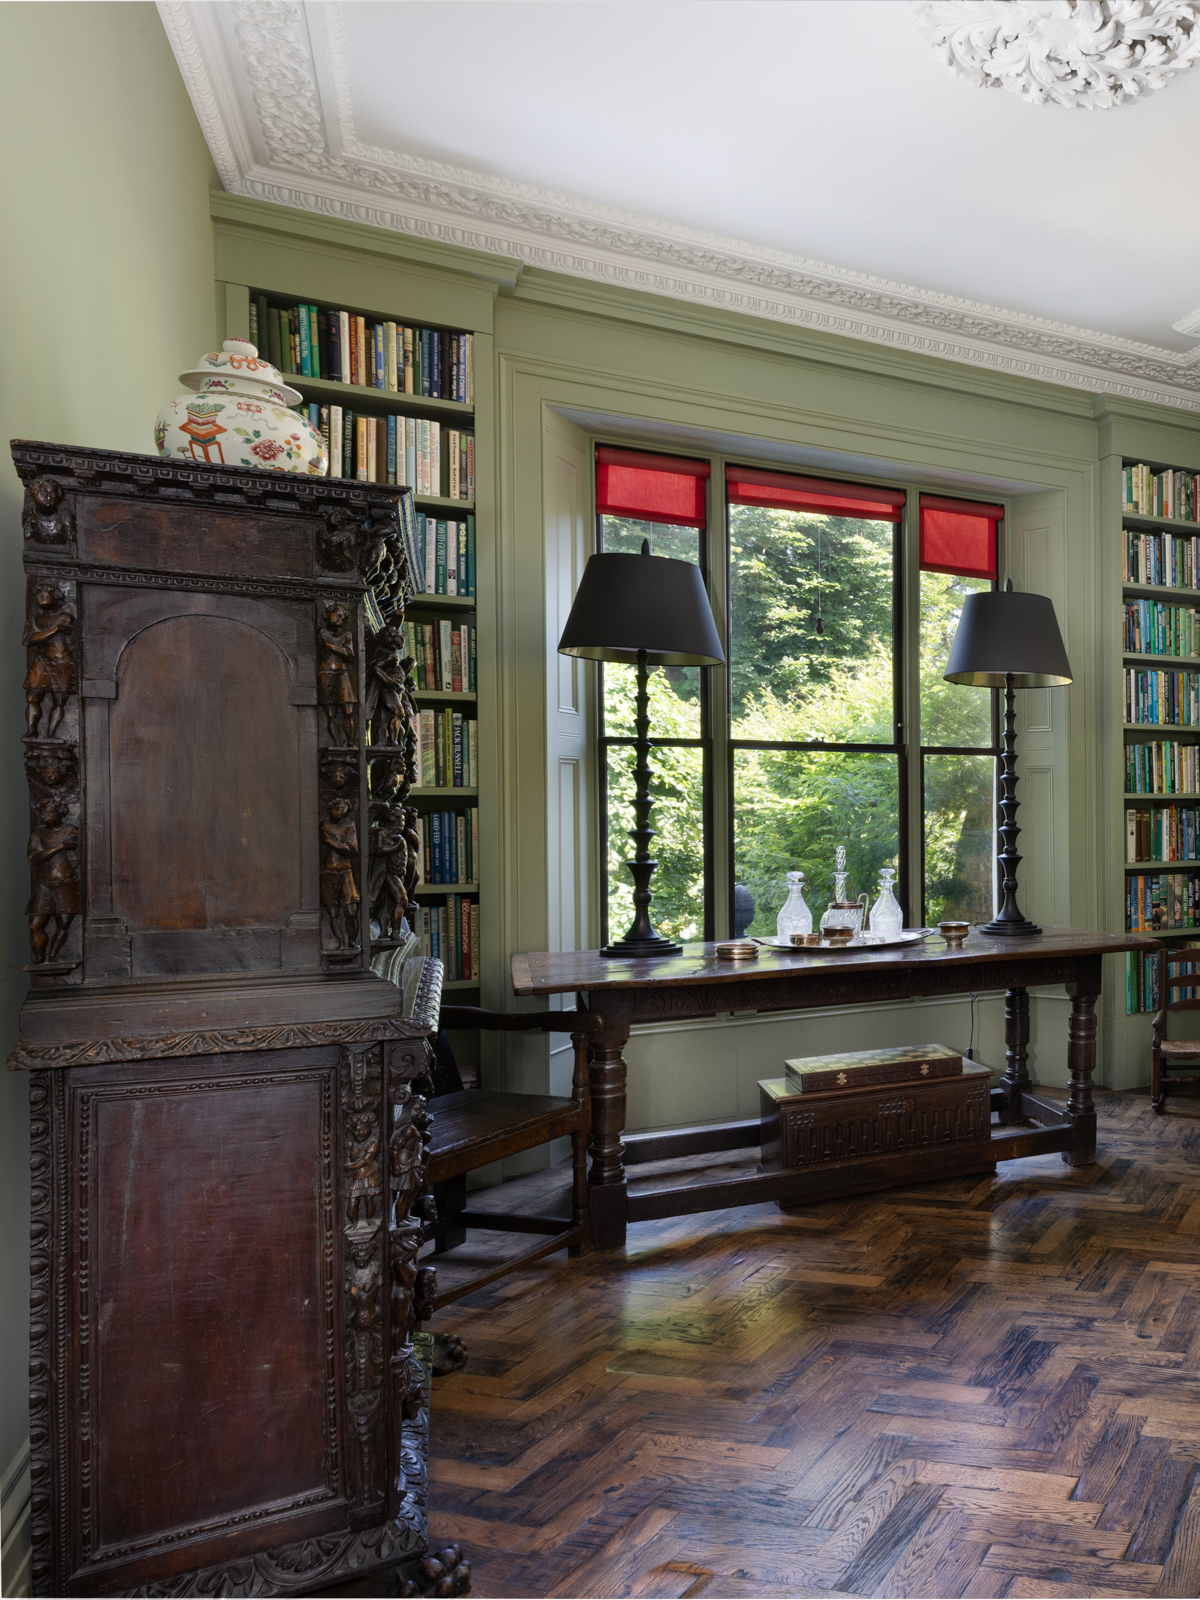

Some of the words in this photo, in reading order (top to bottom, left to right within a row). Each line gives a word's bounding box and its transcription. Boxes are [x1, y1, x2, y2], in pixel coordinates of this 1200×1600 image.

[437, 524, 445, 541] DAVID
[459, 523, 467, 554] GOWER
[437, 542, 445, 565] GOWER
[454, 745, 462, 775] RUSSELL
